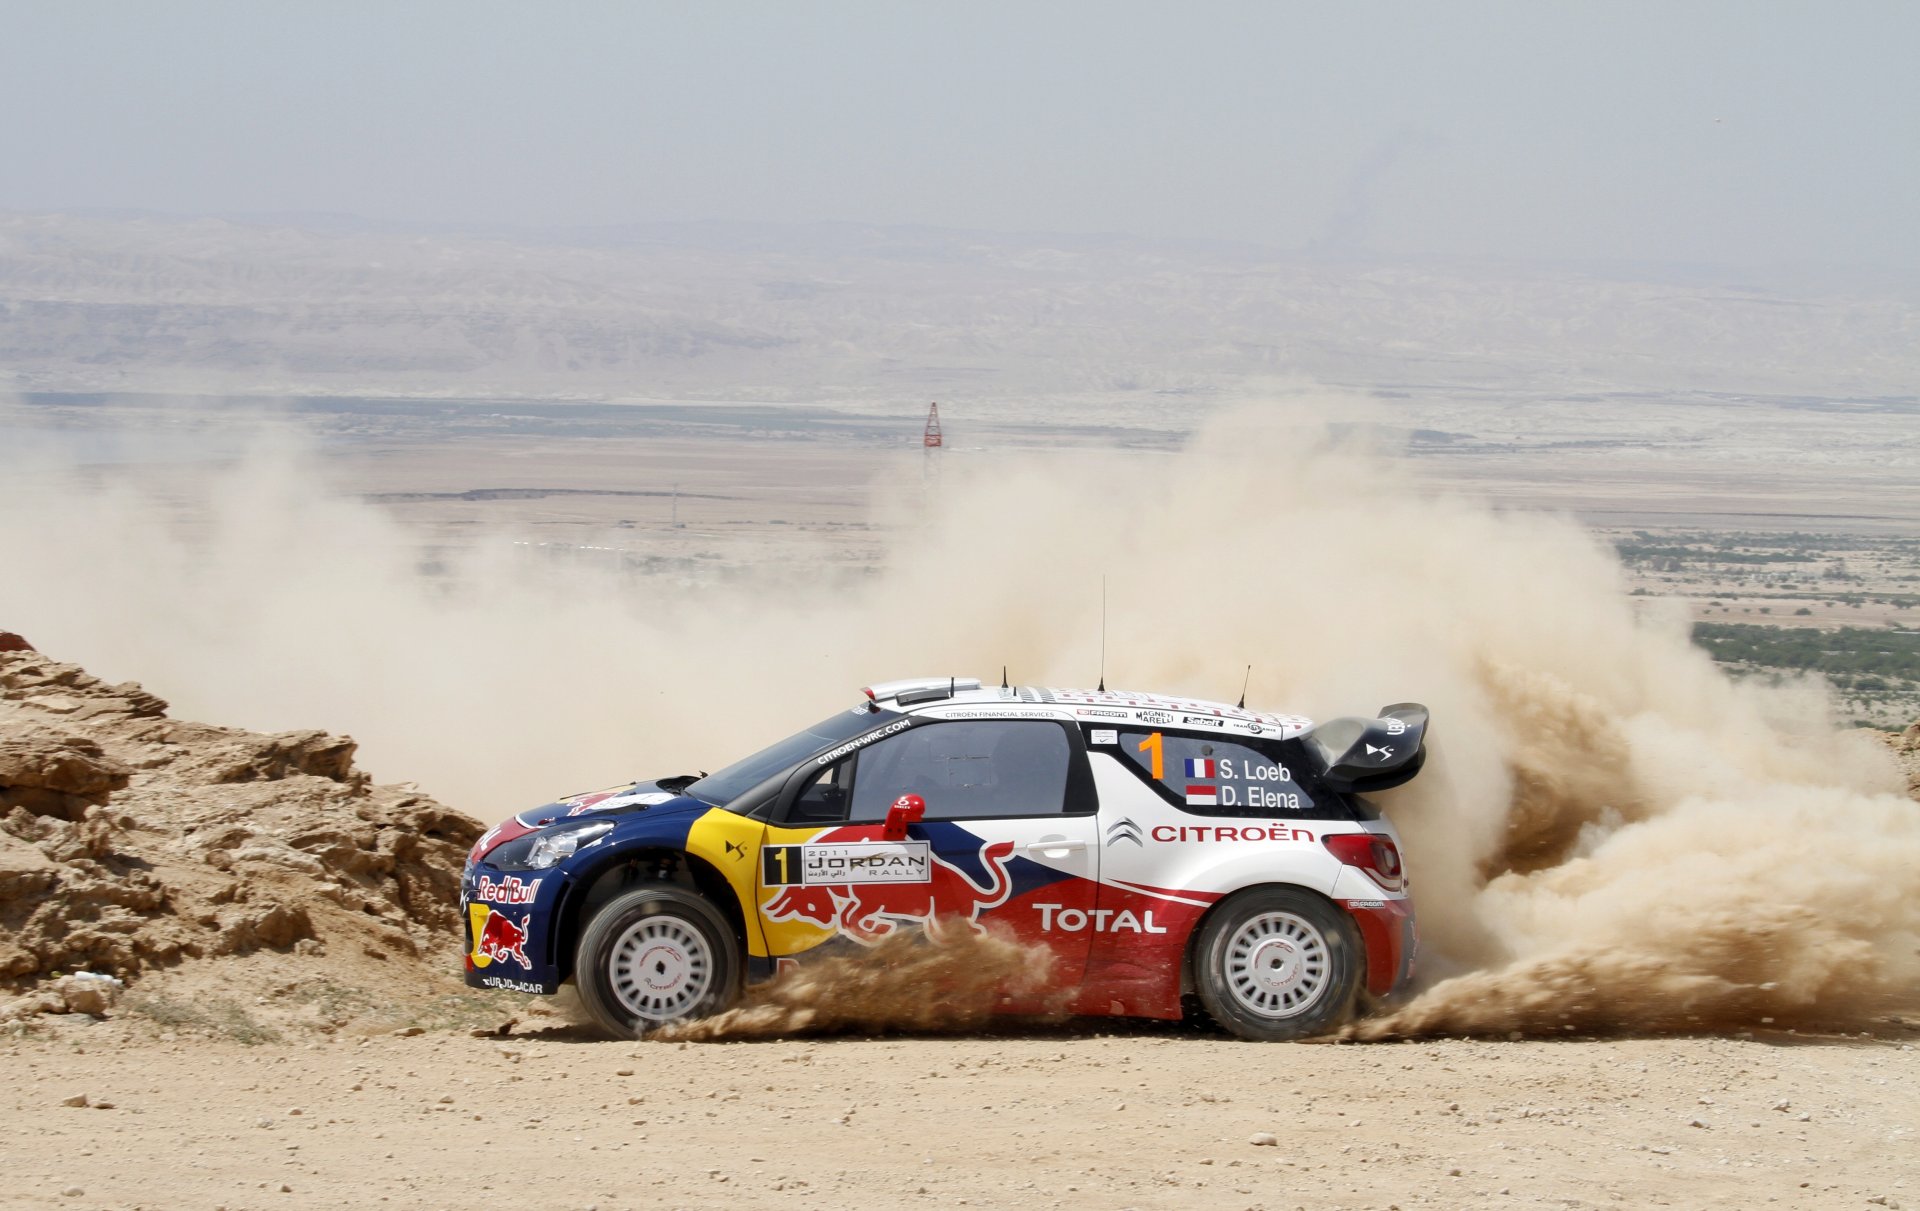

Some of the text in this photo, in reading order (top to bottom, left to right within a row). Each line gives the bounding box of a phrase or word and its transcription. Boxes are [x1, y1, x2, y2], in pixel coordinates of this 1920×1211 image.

[1186, 717, 1221, 727] Sabelt
[817, 719, 911, 766] CITROEN-WRC.COM
[1138, 732, 1164, 780] 1
[1220, 759, 1291, 782] S. Loeb
[1222, 785, 1300, 809] D. Elena
[774, 847, 788, 884] 1
[808, 856, 925, 869] JORDAN
[477, 875, 543, 904] Red Bull
[1032, 903, 1166, 934] TOTAL
